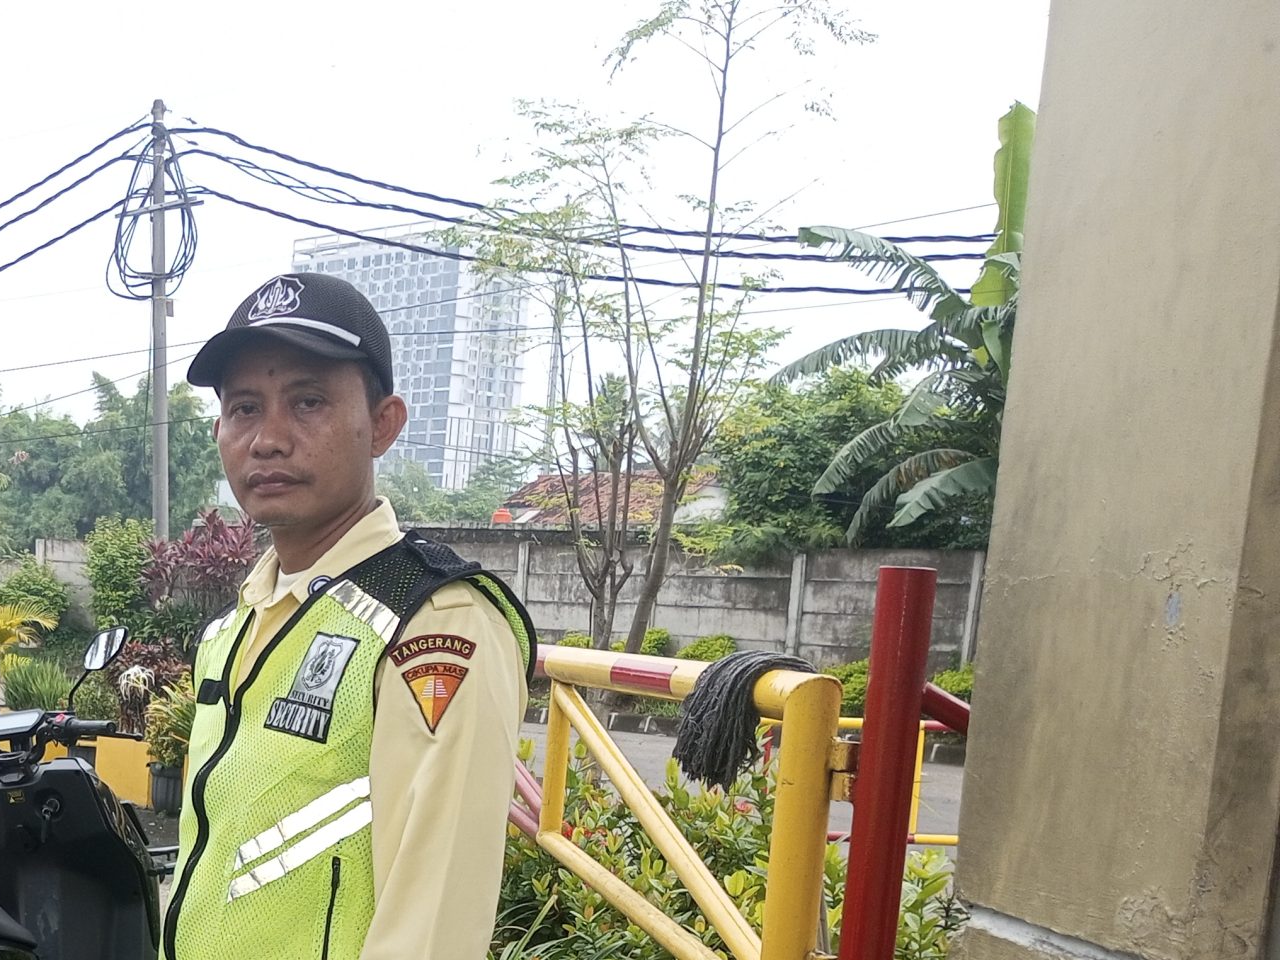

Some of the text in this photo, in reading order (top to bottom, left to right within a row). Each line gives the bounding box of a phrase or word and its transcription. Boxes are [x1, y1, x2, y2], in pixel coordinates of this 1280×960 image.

[392, 638, 471, 661] TANGERANG
[406, 665, 464, 679] CIKUPA MAS
[290, 690, 329, 707] SECURITY
[266, 700, 330, 739] SECURITY
